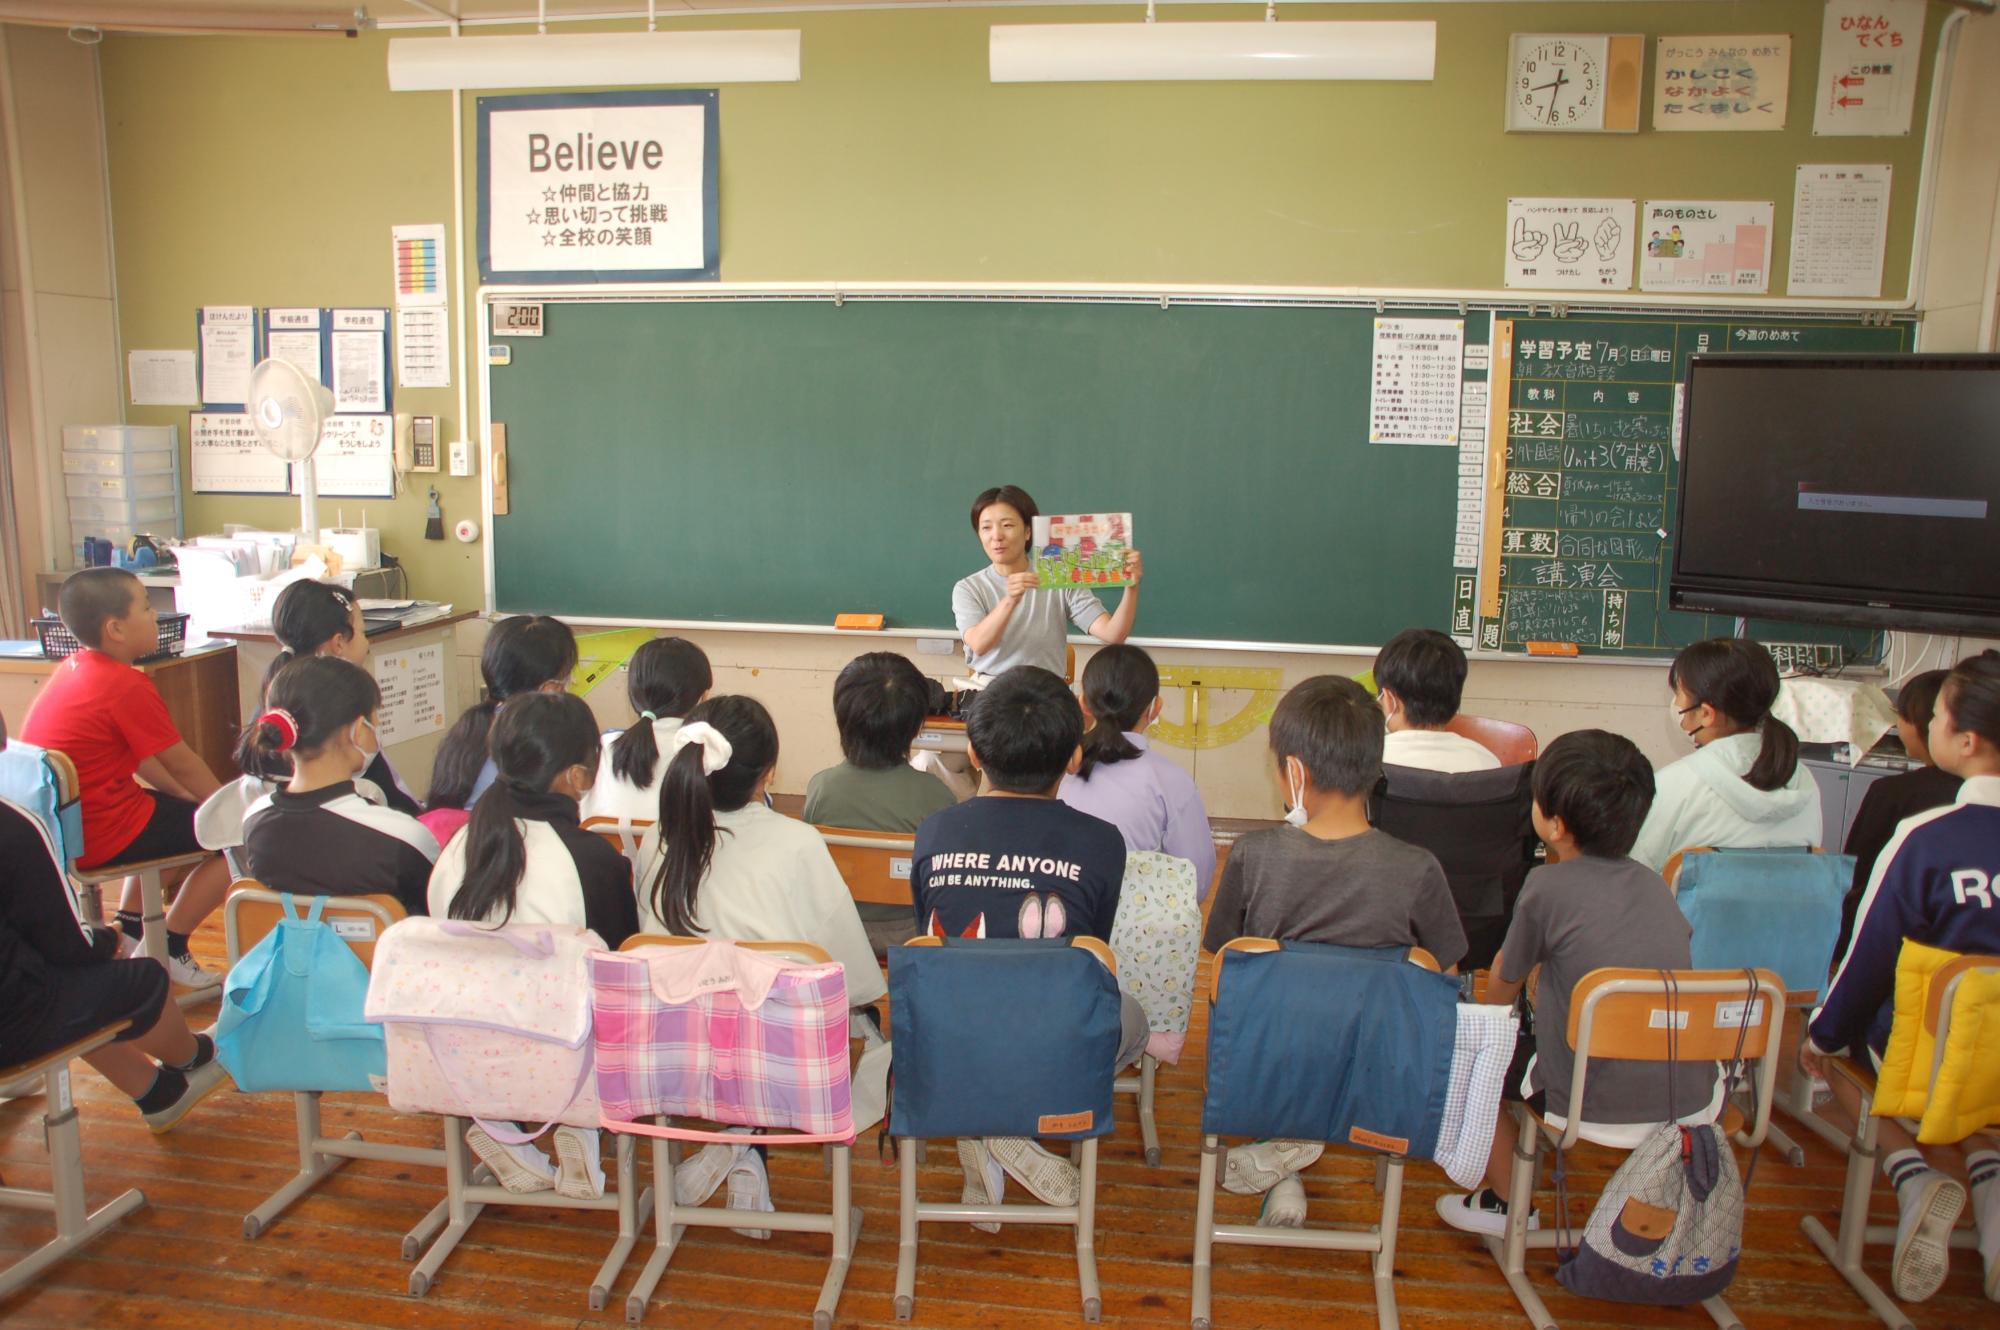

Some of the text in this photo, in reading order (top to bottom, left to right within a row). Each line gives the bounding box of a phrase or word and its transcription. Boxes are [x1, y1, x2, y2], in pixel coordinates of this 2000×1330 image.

[1840, 15, 1889, 31] ひなん
[1855, 32, 1903, 48] でぐち
[1538, 49, 1547, 61] 11
[1554, 45, 1565, 57] 12
[1526, 61, 1536, 73] 10
[1582, 62, 1590, 74] 2
[1665, 67, 1753, 80] かしこく
[1521, 77, 1529, 89] 9
[1585, 78, 1593, 91] 3
[1664, 85, 1751, 97] なかよく
[1524, 94, 1533, 105] 8
[1579, 95, 1587, 106] 4
[1536, 106, 1544, 117] 7
[1567, 106, 1576, 118] 5
[1663, 102, 1774, 114] たくましく
[1551, 110, 1560, 122] 6
[528, 131, 664, 173] Believe
[559, 182, 650, 204] 仲間と協力
[543, 203, 669, 226] 思い切って挑戦
[1652, 208, 1718, 219] 声のものさし
[558, 226, 653, 248] 全校の笑顔
[209, 312, 248, 321] ほけんだより
[343, 316, 374, 325] 学校通信
[1735, 328, 1800, 342] 今週のめあて
[1520, 340, 1592, 361] 学習予定
[1527, 388, 1640, 405] 教科 内容
[1509, 412, 1561, 436] 社会
[1505, 471, 1557, 496] 総合
[1503, 530, 1554, 553] 算数
[1531, 560, 1624, 589] 講演会
[1455, 579, 1473, 631] 日直
[1604, 592, 1624, 646] 持ち物
[931, 852, 1082, 882] WHERE ANYONE
[928, 873, 1036, 889] CAN BE ANYTHING.
[1950, 868, 2000, 909] R
